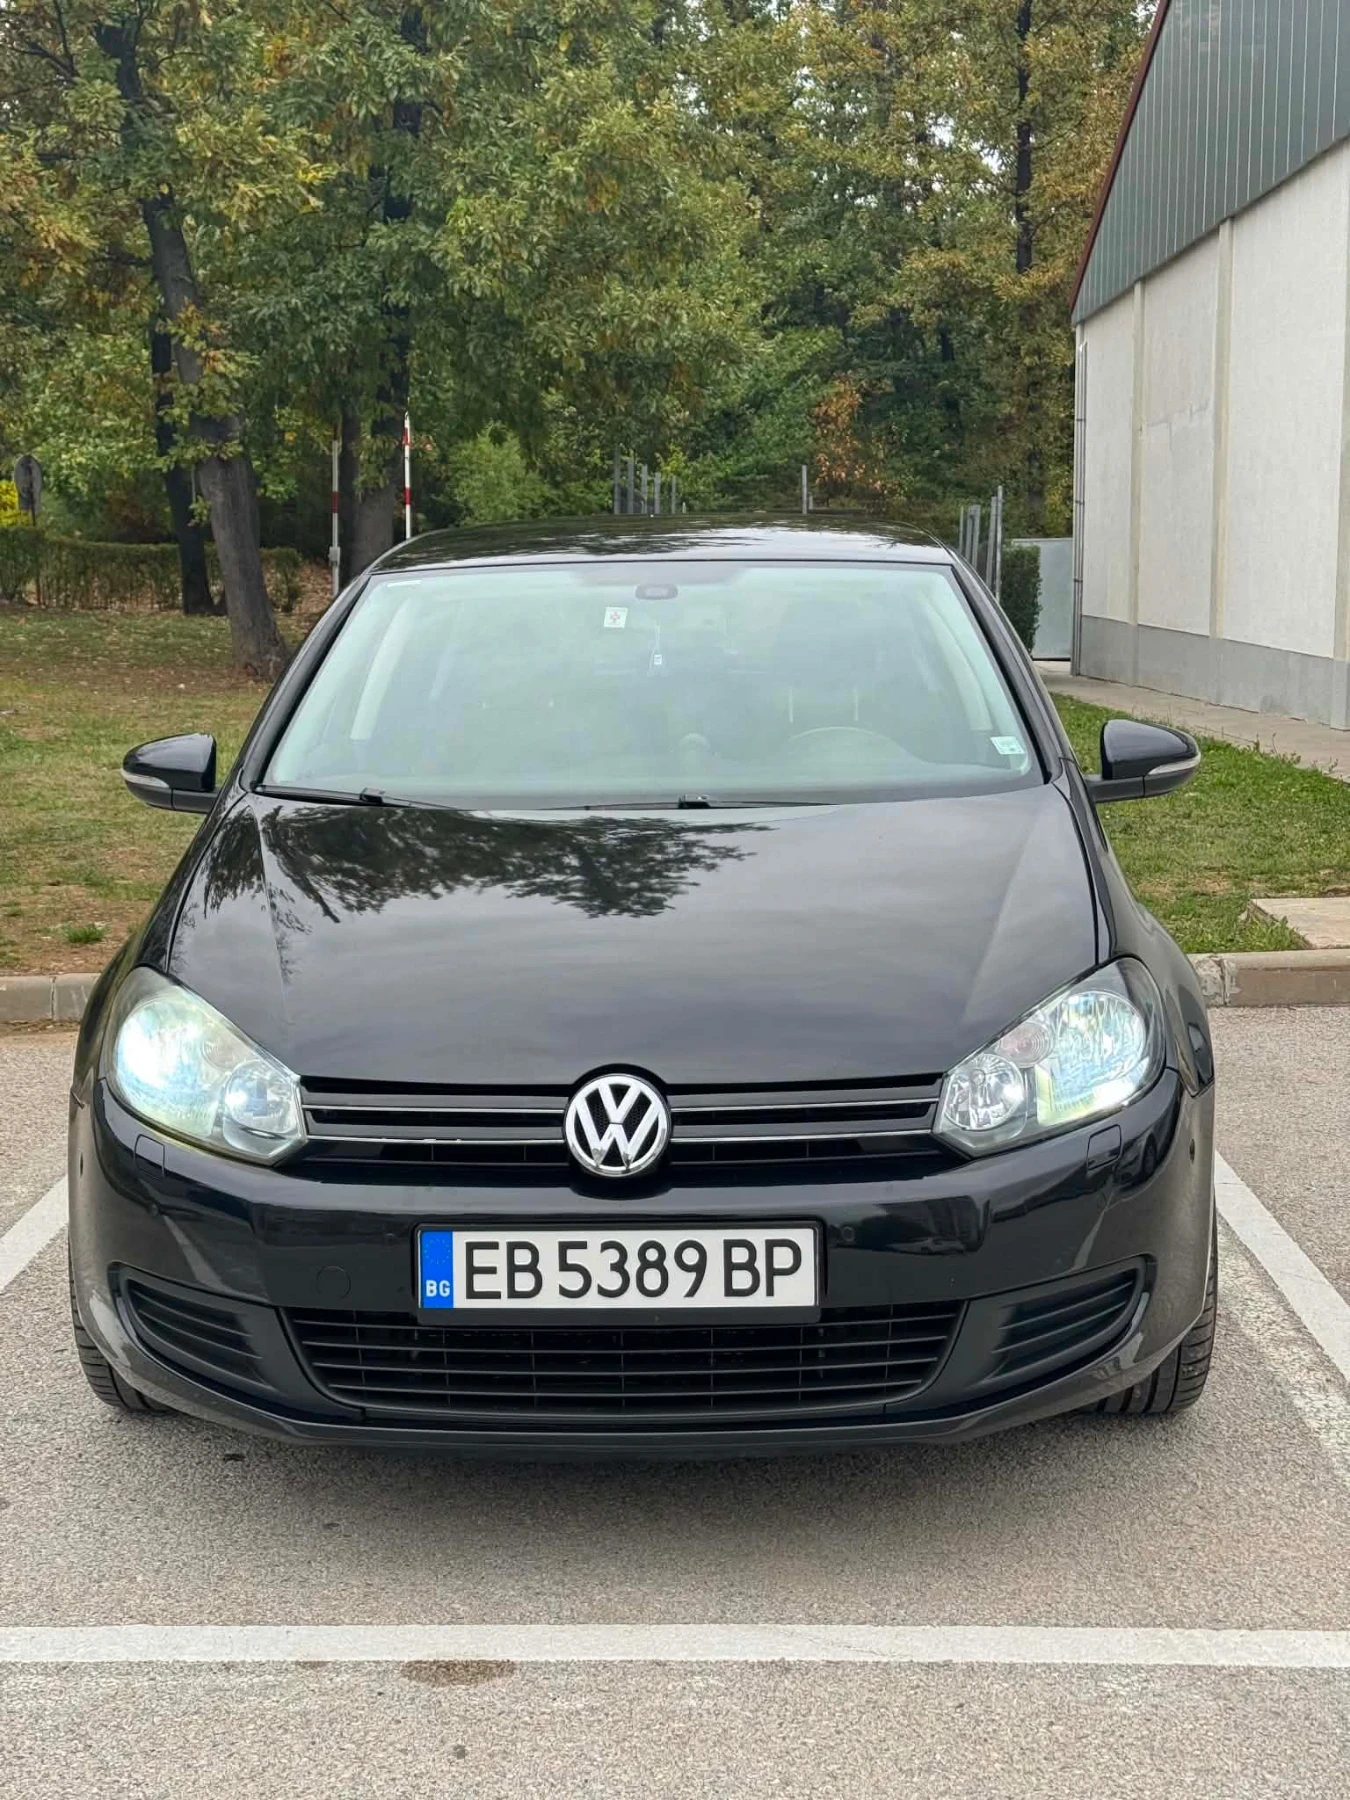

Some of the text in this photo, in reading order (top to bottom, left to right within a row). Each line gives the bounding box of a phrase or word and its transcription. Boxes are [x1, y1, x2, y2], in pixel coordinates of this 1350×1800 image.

[570, 1075, 664, 1172] VW
[425, 1279, 451, 1298] BG
[464, 1238, 802, 1300] EB 5389 BP
